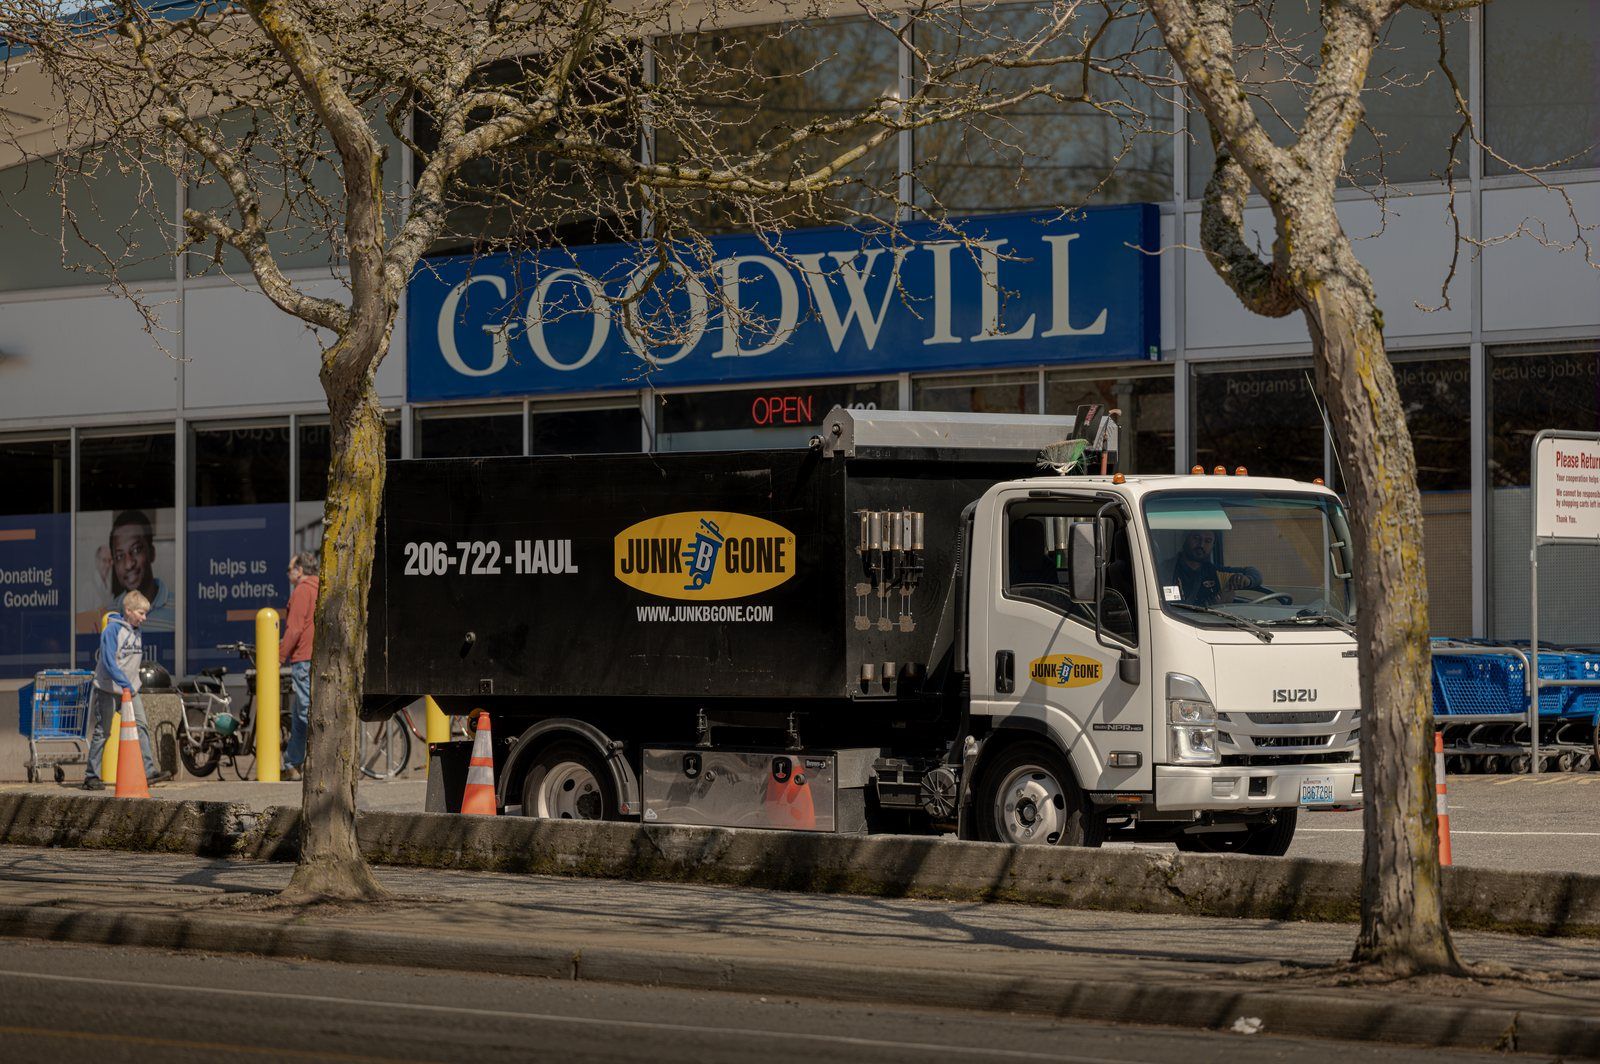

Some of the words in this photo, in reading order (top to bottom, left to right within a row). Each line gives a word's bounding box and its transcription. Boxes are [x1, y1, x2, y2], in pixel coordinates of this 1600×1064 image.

[437, 233, 1108, 377] GOODWILL
[1418, 367, 1437, 384] to
[1440, 367, 1470, 383] wor
[1492, 363, 1546, 380] ecause
[1548, 359, 1584, 382] jobs
[1226, 378, 1296, 398] Programs
[752, 395, 813, 426] OPEN
[1556, 451, 1579, 469] Please
[1580, 452, 1600, 469] Retur
[1556, 515, 1568, 523] Thank
[620, 538, 683, 574] JUNK
[695, 541, 714, 572] B
[725, 537, 786, 574] GONE
[210, 557, 247, 578] helps
[250, 559, 267, 575] us
[3, 589, 59, 608] Goodwill
[198, 581, 228, 603] help
[231, 580, 279, 599] others.
[636, 605, 774, 623] WWW.JUNKBGONE.COM
[1031, 663, 1057, 678] JUNK
[1061, 664, 1070, 677] B
[1073, 664, 1099, 679] GONE
[1272, 688, 1318, 703] ISUZU
